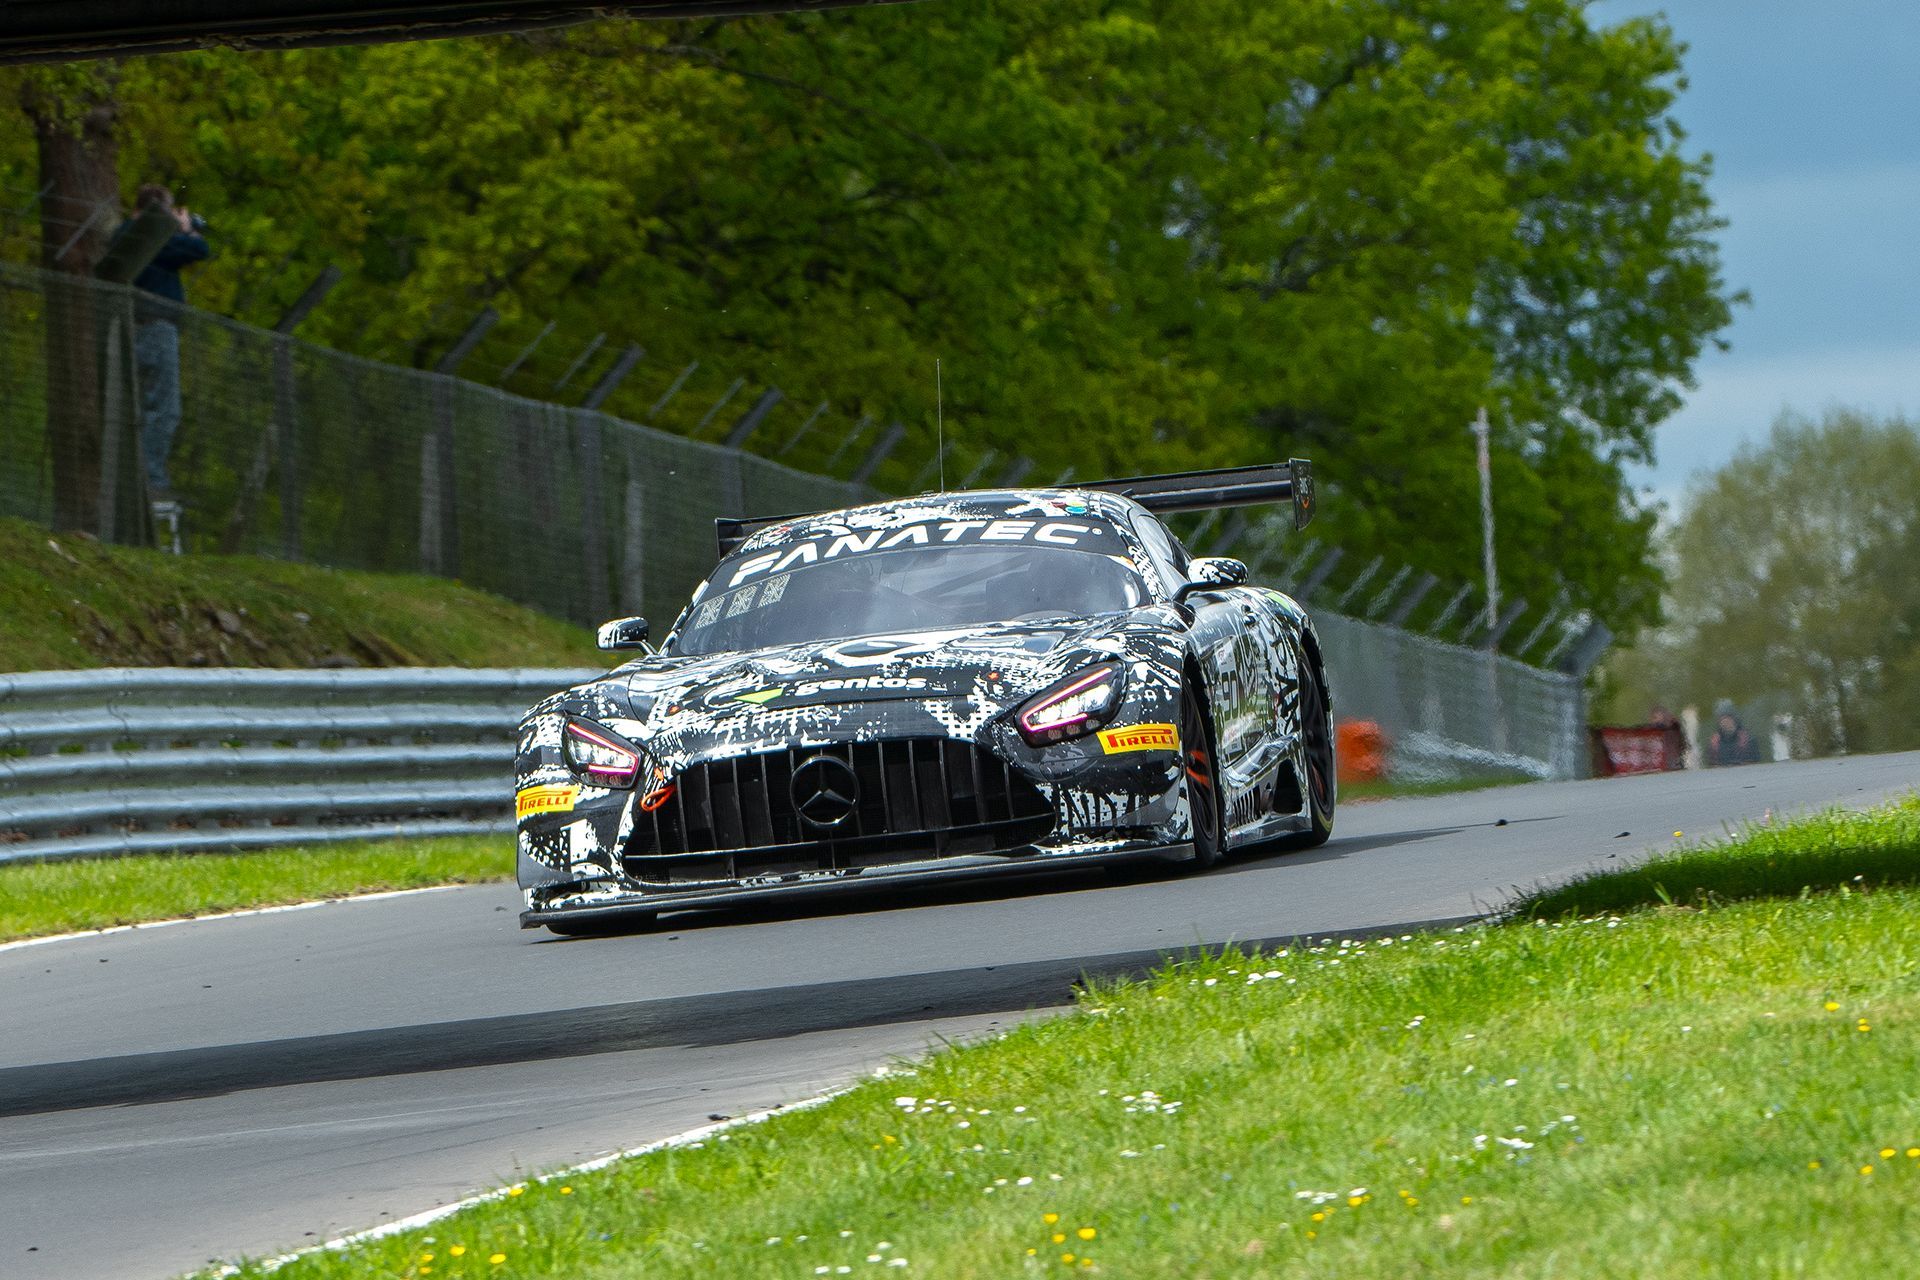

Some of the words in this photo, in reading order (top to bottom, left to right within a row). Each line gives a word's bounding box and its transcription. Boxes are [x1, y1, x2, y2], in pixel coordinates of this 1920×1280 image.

[728, 520, 1090, 587] FANATEC
[794, 675, 927, 696] gentos
[1107, 729, 1175, 748] PIRELLI
[519, 791, 571, 811] PIRELLI
